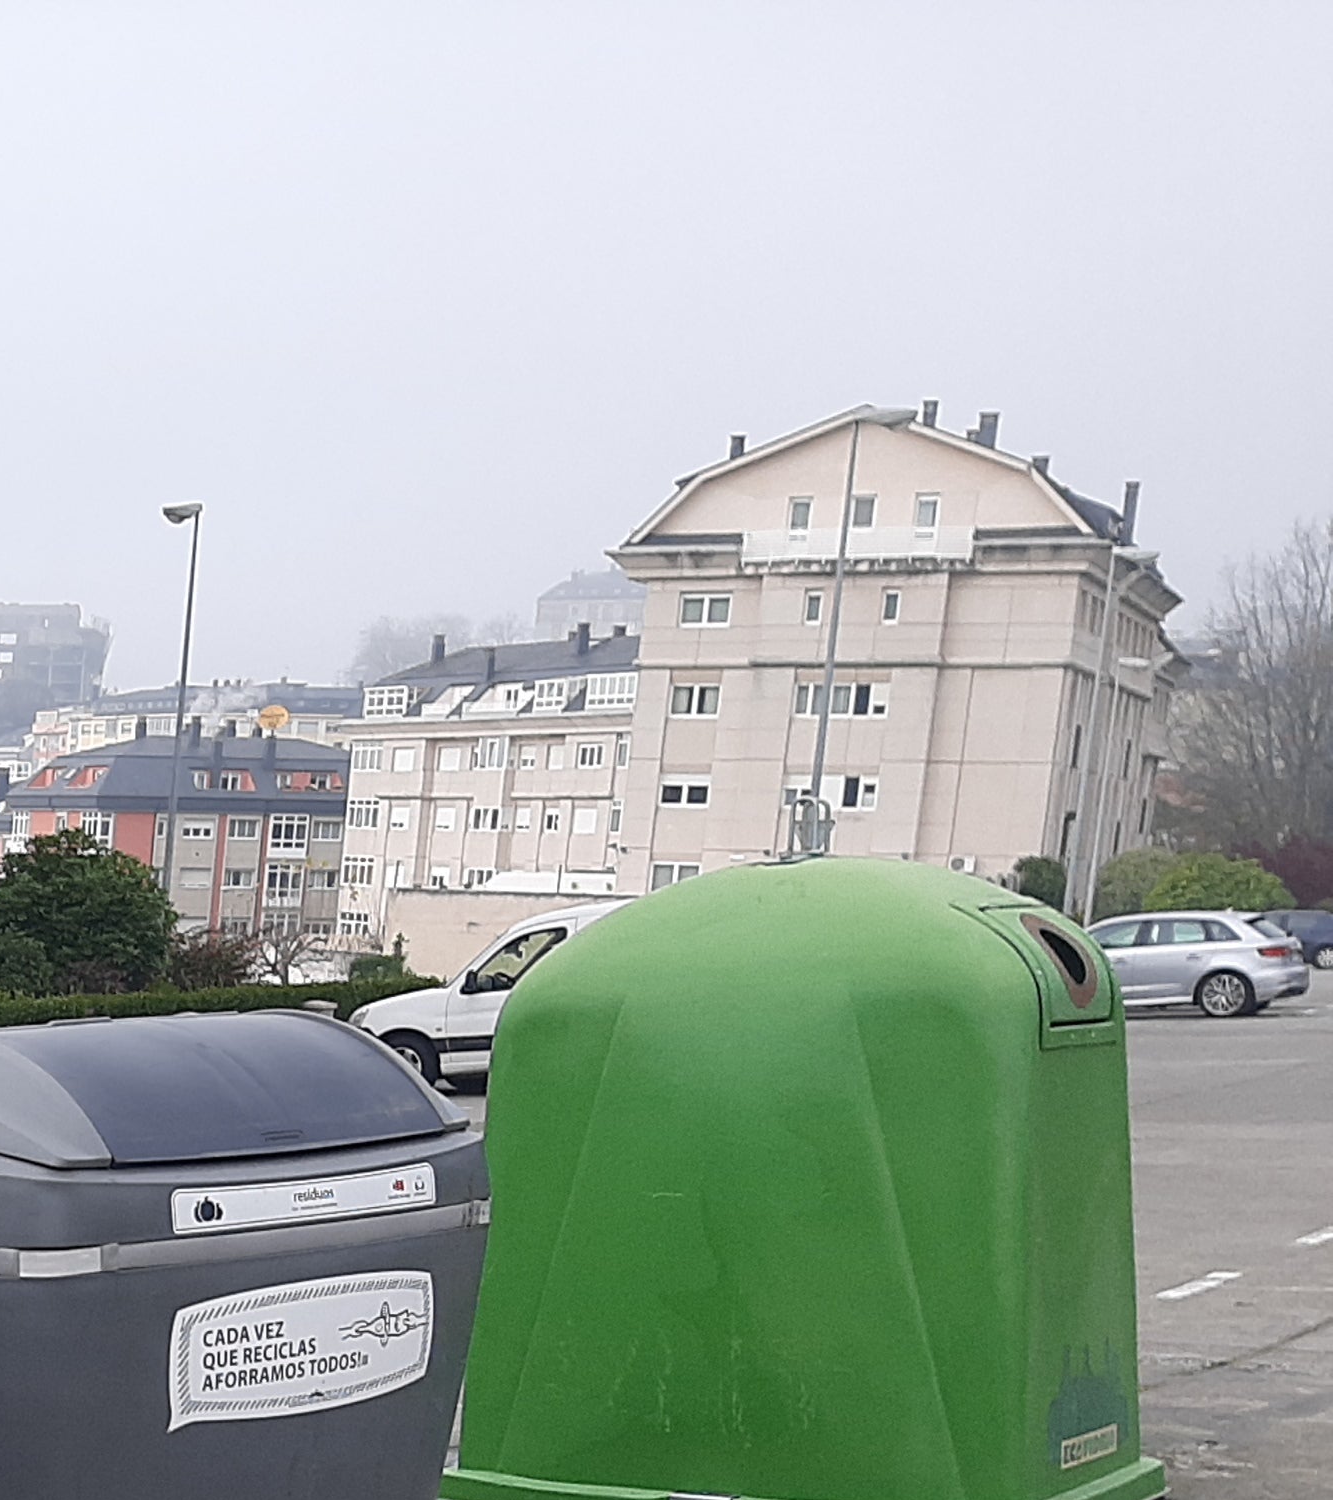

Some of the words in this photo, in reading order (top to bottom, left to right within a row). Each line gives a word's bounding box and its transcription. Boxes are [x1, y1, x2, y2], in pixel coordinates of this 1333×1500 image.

[203, 1326, 250, 1347] CADA
[254, 1321, 284, 1340] VEZ
[203, 1349, 238, 1370] QUE
[243, 1337, 316, 1365] RECICLAS
[202, 1361, 305, 1392] AFORRAMOS
[310, 1351, 361, 1376] TODOS!
